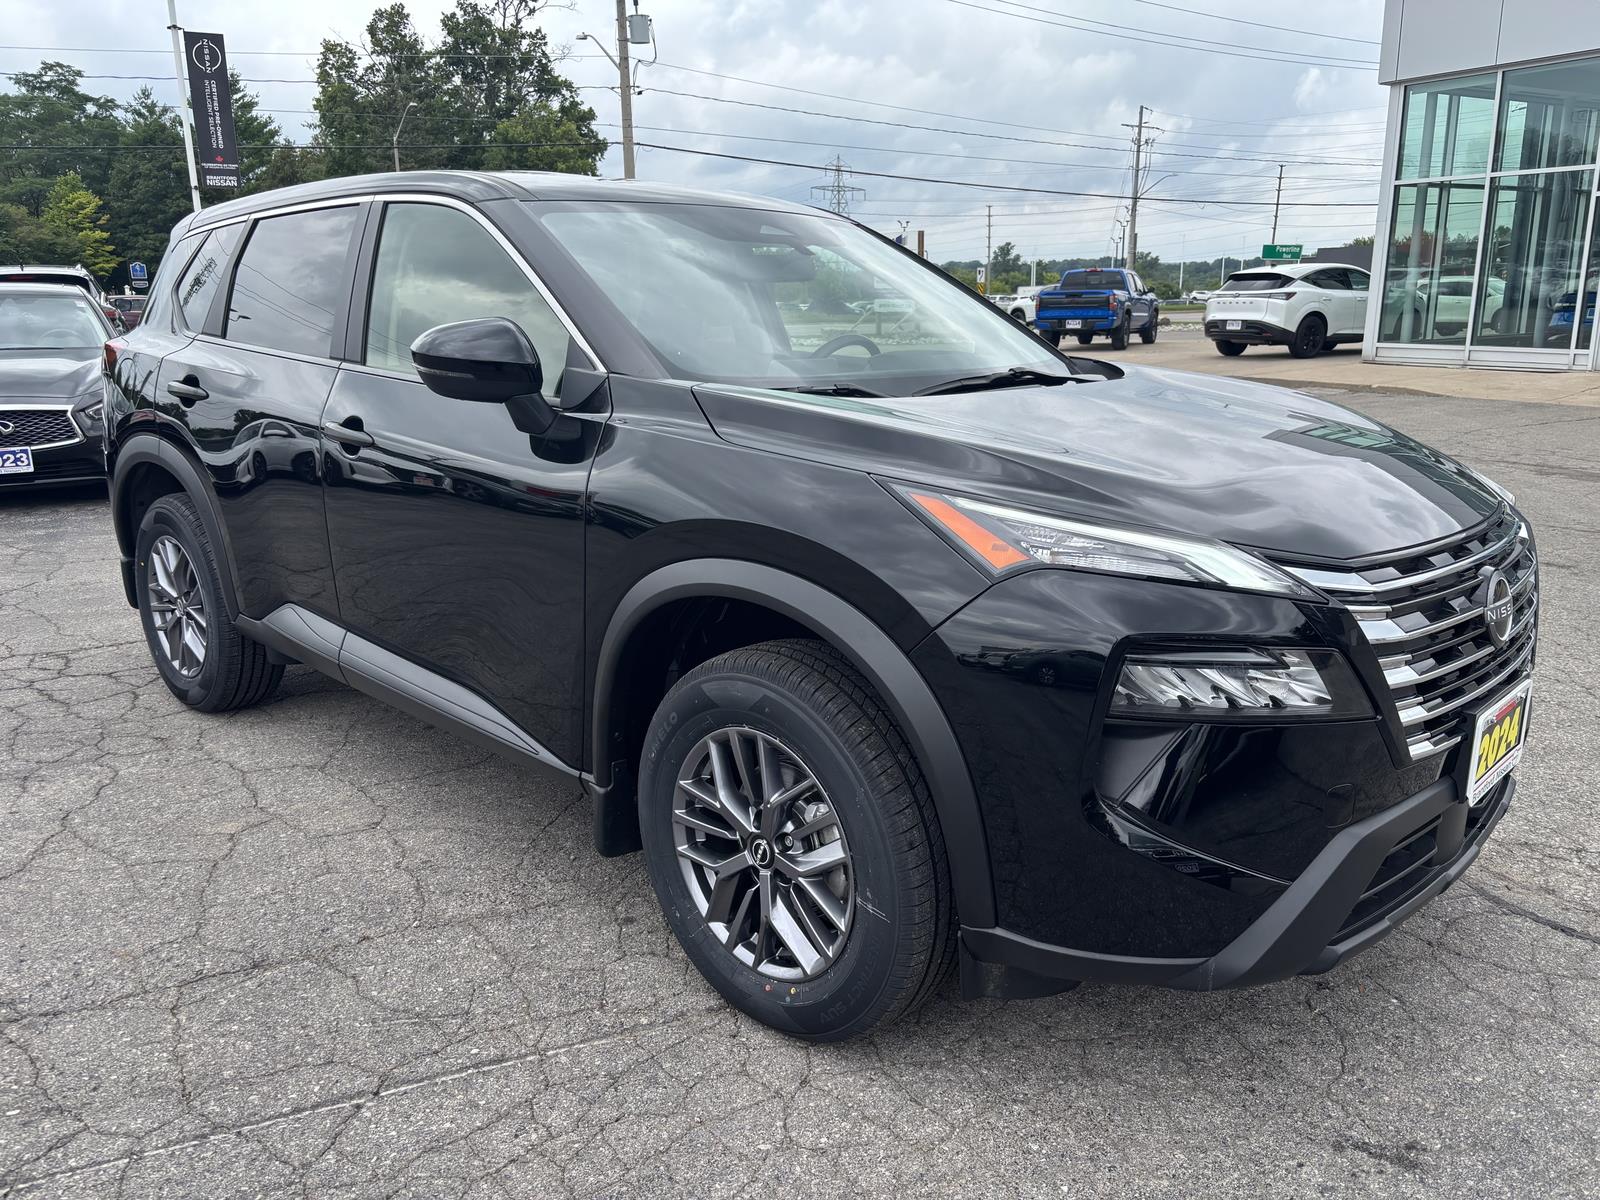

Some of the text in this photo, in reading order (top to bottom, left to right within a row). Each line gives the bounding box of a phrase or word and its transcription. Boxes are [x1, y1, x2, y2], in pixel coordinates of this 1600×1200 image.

[202, 39, 212, 73] NISSAN
[204, 80, 217, 148] INTELLIGENT SELECTION
[210, 80, 224, 149] CERTIFIED PRE-OWNED
[206, 179, 238, 187] NISSAN
[0, 452, 29, 467] 23
[1487, 603, 1512, 622] NISS
[1475, 705, 1521, 781] 2024
